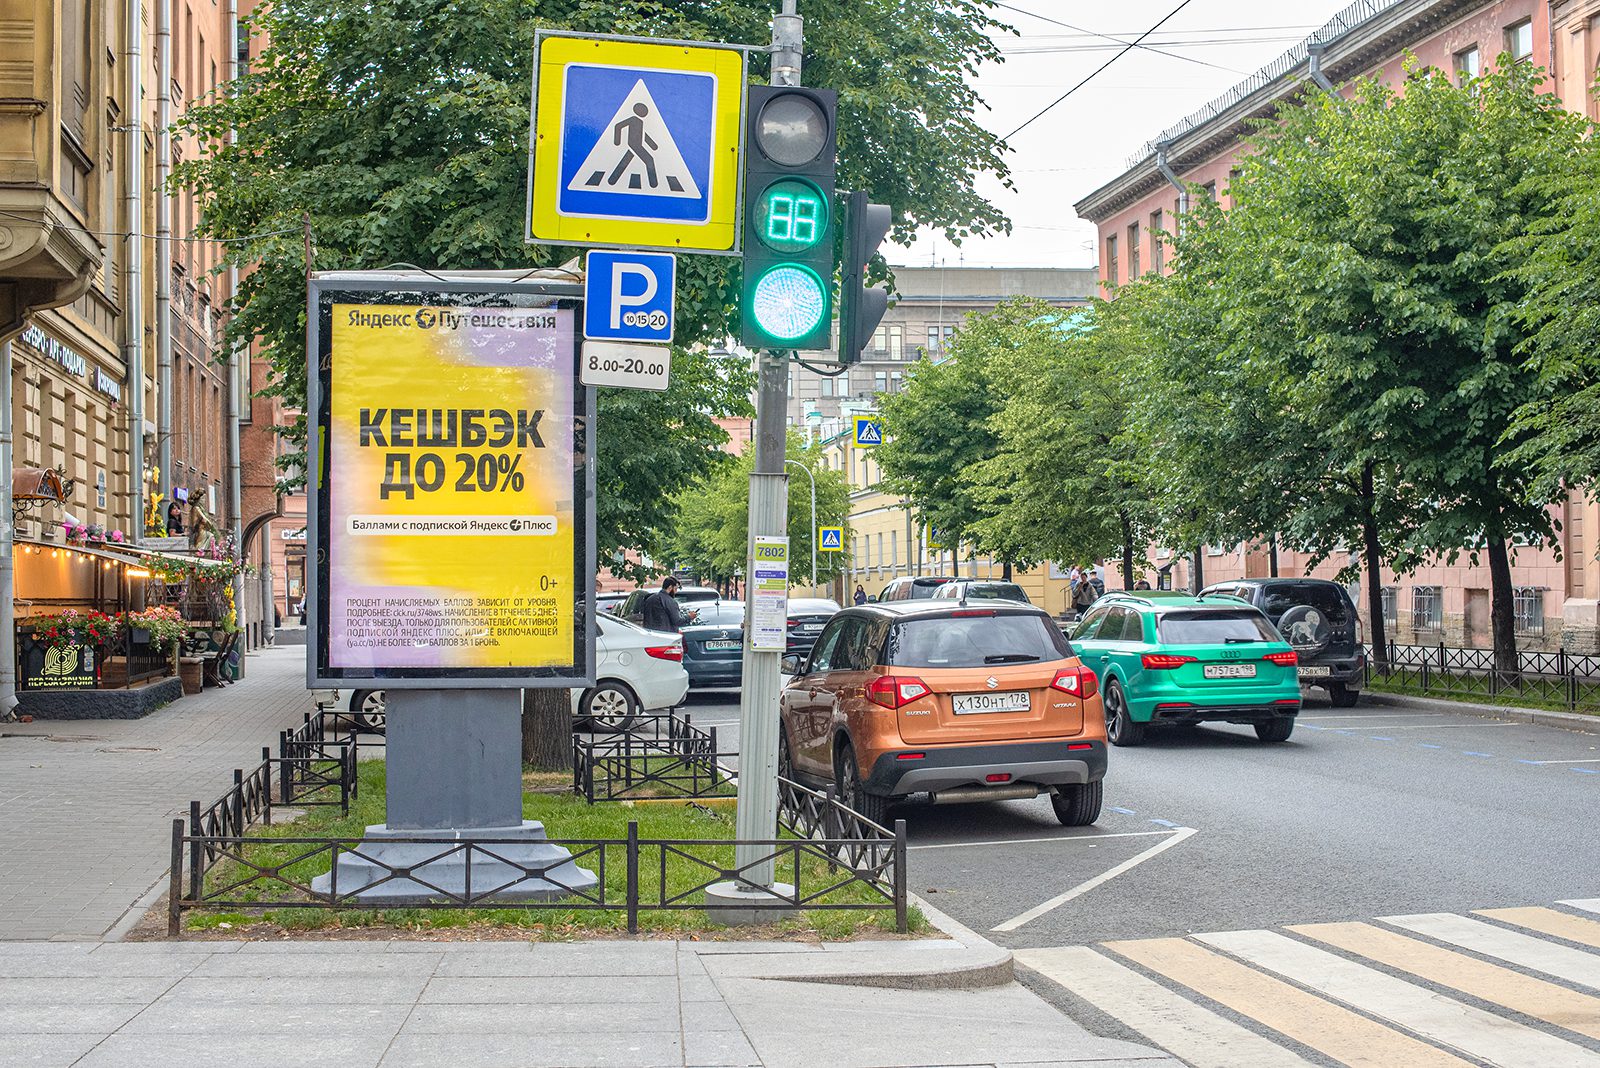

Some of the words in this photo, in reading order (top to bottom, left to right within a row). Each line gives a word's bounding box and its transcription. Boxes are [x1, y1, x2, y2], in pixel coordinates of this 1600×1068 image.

[769, 196, 817, 242] 88
[610, 262, 657, 329] P
[348, 310, 411, 328] Яндекс
[440, 310, 556, 330] Путешествия
[626, 315, 634, 323] 10
[637, 315, 647, 324] 15
[651, 315, 666, 326] 20
[588, 356, 664, 376] 8.00-20.00
[360, 408, 546, 448] КЕШБЭК
[380, 453, 446, 500] ДО
[455, 453, 524, 492] 20%
[352, 520, 400, 530] Баллами
[402, 522, 408, 530] с
[410, 520, 468, 532] подпиской
[470, 520, 509, 532] Яндекс
[522, 520, 552, 530] Плюс
[758, 547, 785, 558] 7802
[540, 575, 558, 591] 0+
[346, 598, 381, 607] ПРОЦЕНТ
[385, 598, 440, 606] НАЧИСЛЯЕМЫХ
[444, 598, 474, 606] БАЛЛОВ
[477, 598, 510, 606] ЗАВИСИТ
[514, 598, 524, 606] ОТ
[346, 608, 392, 617] ПОДРОБНЕЕ:
[444, 608, 492, 616] НАЧИСЛЕНИЕ
[538, 607, 558, 616] ДНЕЙ
[346, 618, 372, 626] ПОСЛЕ
[406, 618, 434, 626] ТОЛЬКО
[434, 618, 450, 628] ДЛЯ
[450, 617, 512, 626] ПОЛЬЗОВАТЕЛЕЙ
[518, 617, 558, 626] АКТИВНОЙ
[346, 627, 398, 637] ПОДПИСКОЙ
[400, 628, 433, 637] ЯНДЕКС
[497, 627, 558, 636] ВКЛЮЧАЮЩЕЙ
[388, 639, 411, 647] БОЛЕЕ
[429, 638, 458, 647] БАЛЛОВ
[957, 696, 1006, 710] Х130НТ
[1008, 694, 1027, 703] 178
